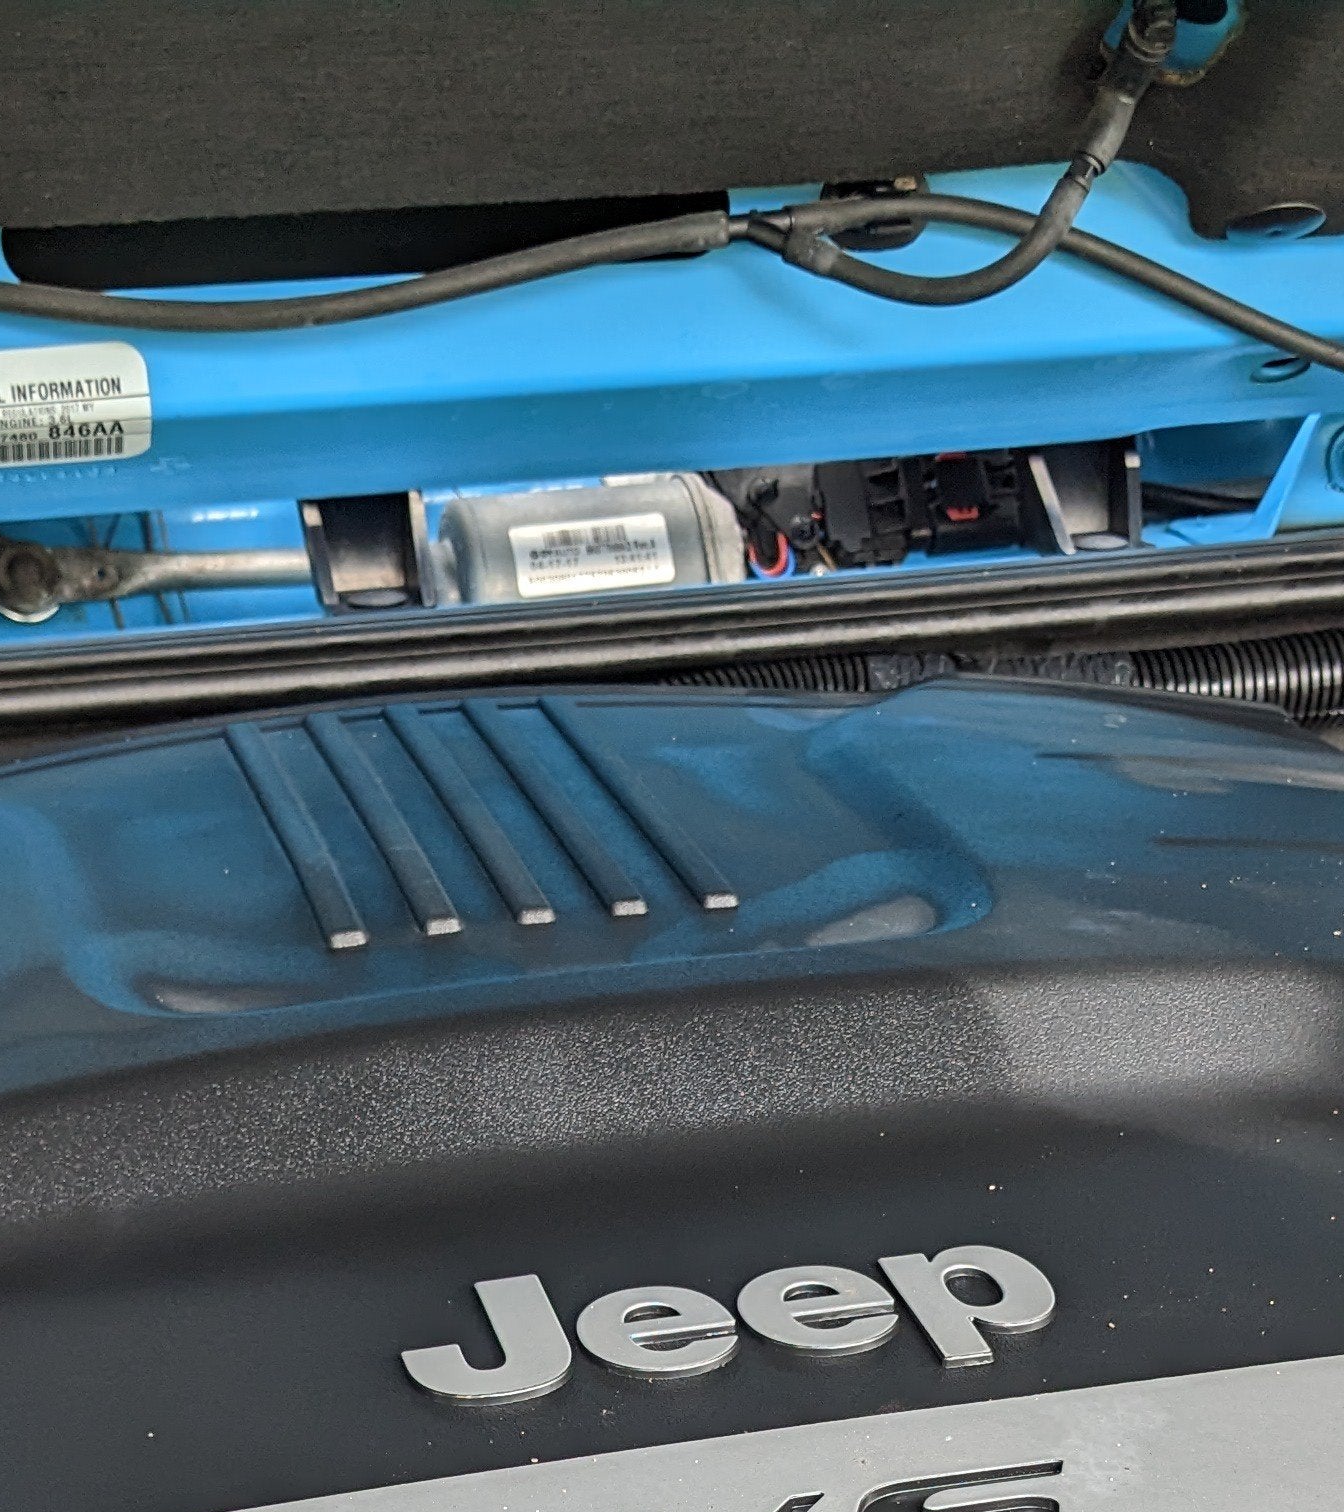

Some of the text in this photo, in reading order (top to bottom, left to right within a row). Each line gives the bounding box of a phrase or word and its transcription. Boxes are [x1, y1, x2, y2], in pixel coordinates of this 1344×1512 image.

[10, 377, 122, 400] INFORMATION
[48, 419, 125, 441] 846AA
[400, 1244, 1057, 1407] Jeep
